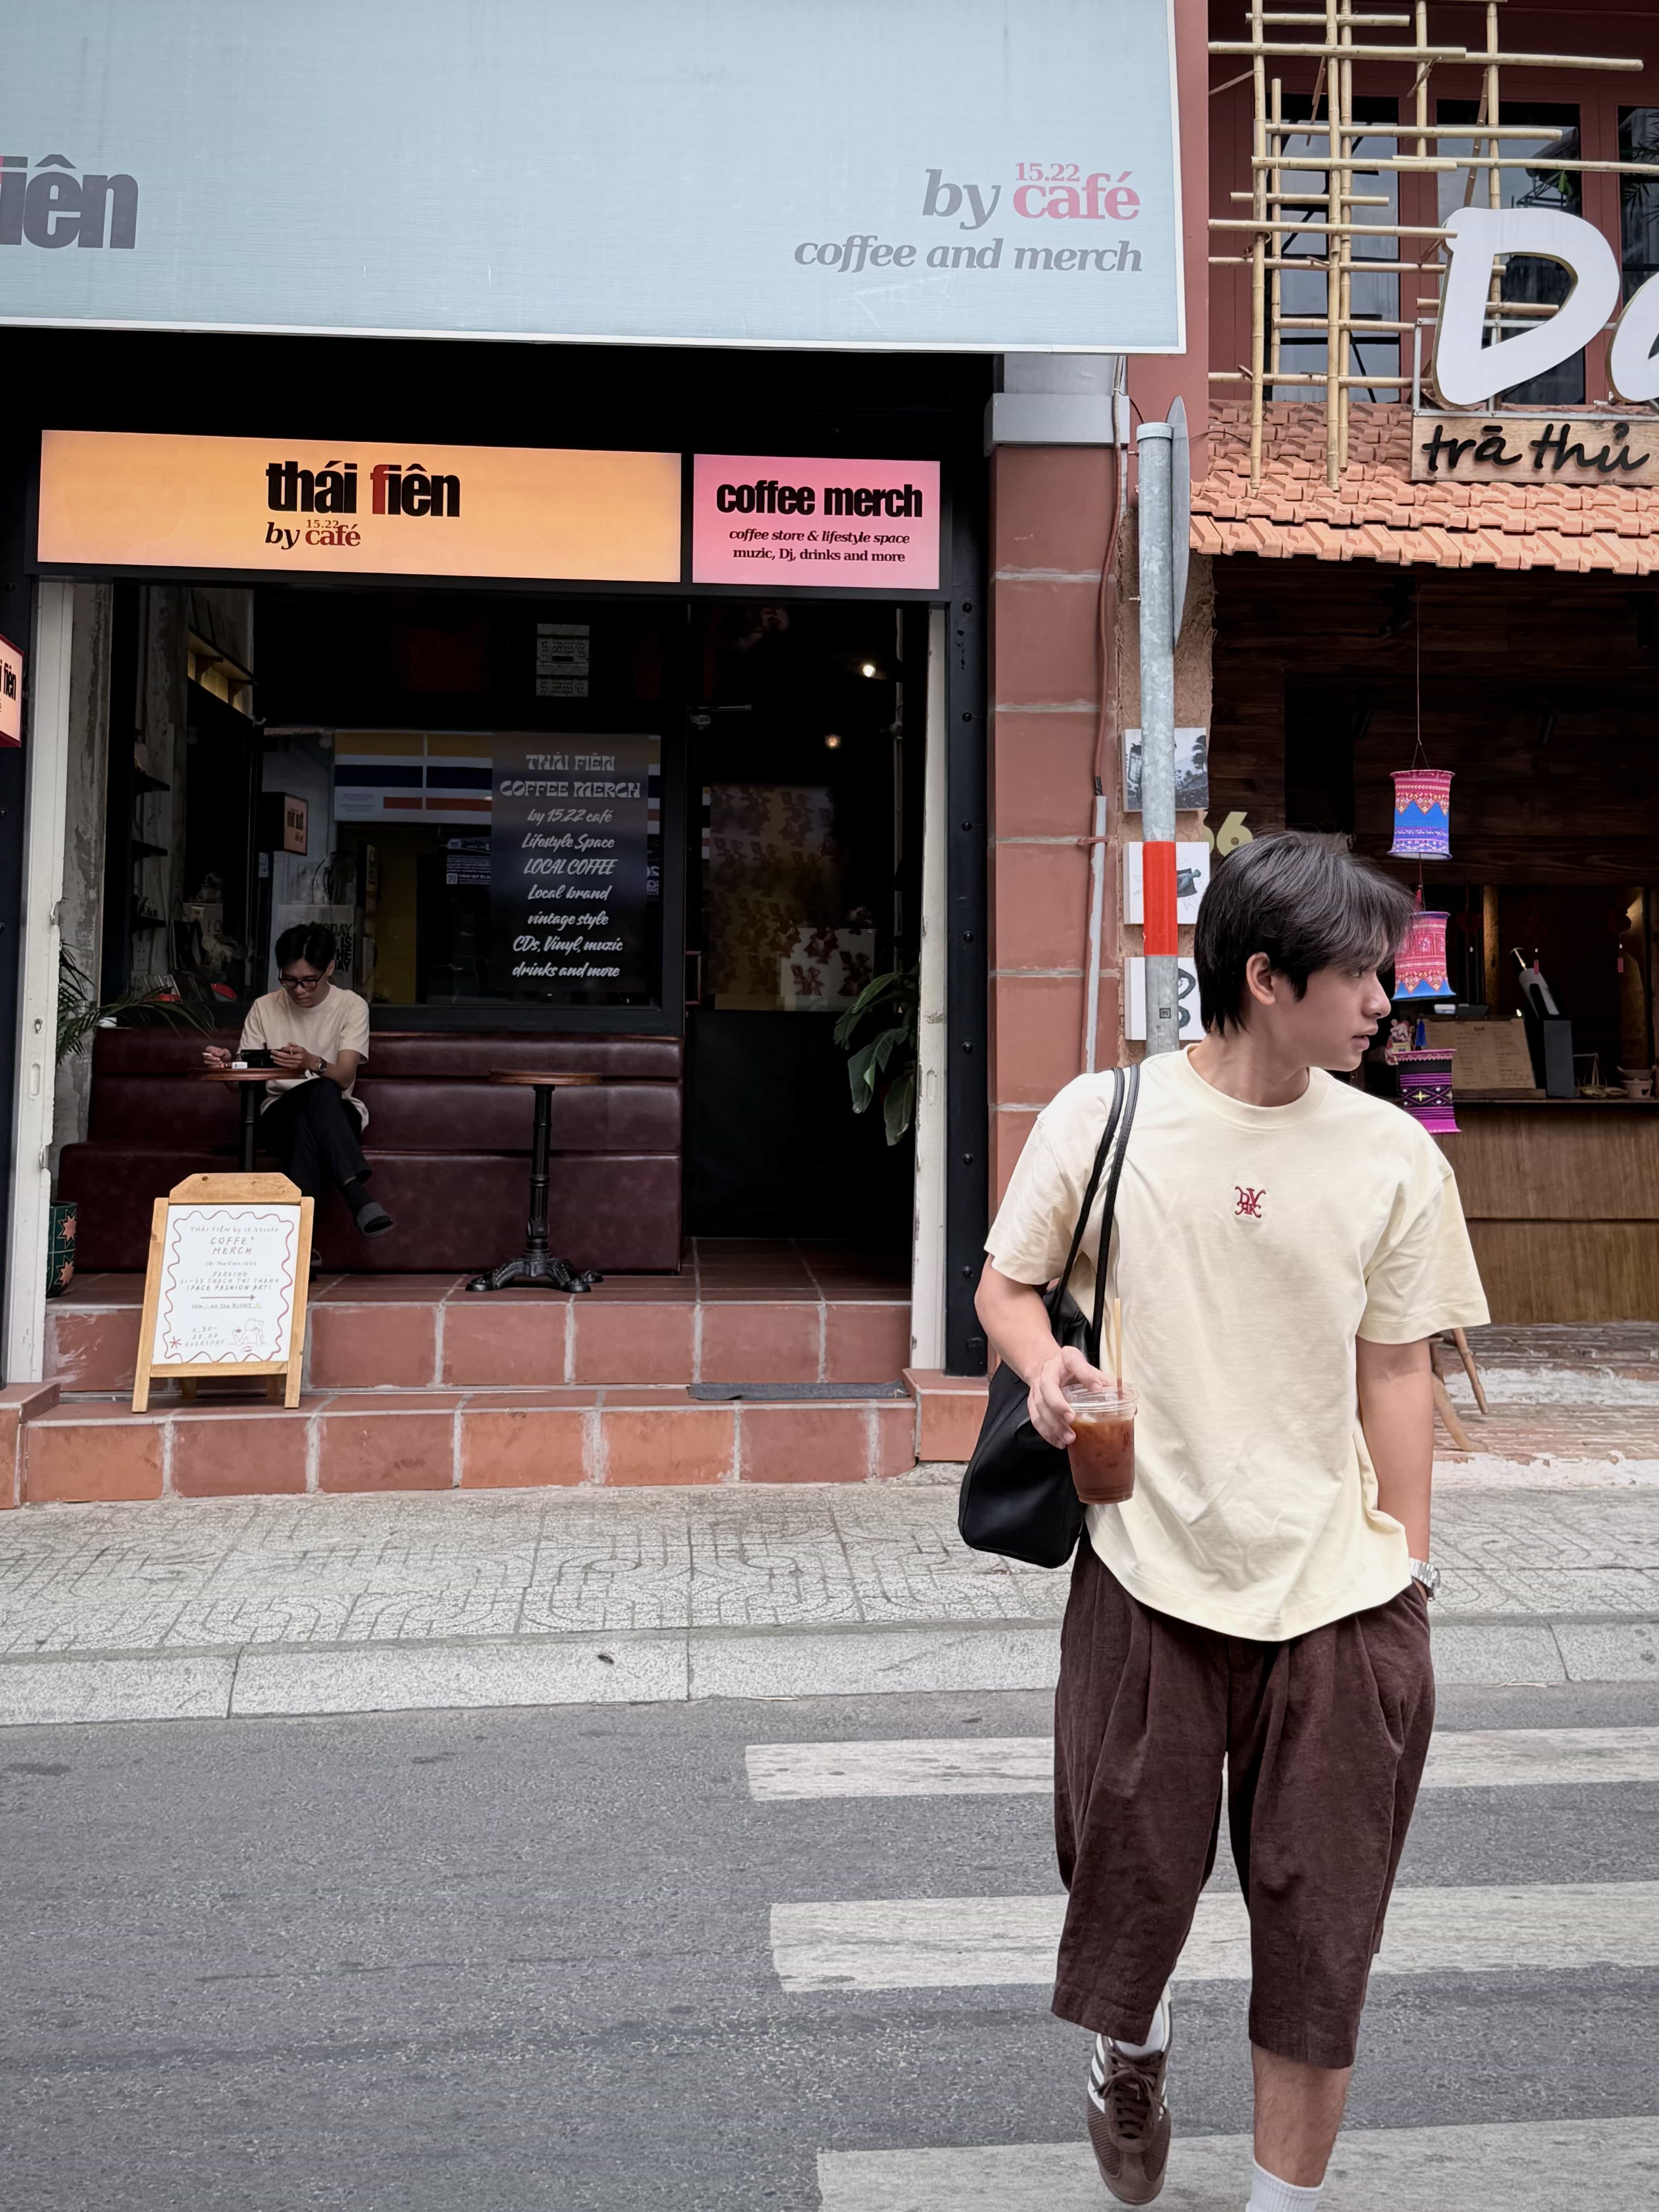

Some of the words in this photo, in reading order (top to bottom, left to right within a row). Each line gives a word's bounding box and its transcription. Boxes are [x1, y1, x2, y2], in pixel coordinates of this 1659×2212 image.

[1015, 162, 1080, 182] 15.22
[0, 154, 138, 249] iên
[922, 169, 1001, 230] by
[1012, 171, 1140, 220] café
[794, 235, 917, 273] coffee
[926, 238, 1004, 269] and
[1014, 240, 1143, 271] merch
[1529, 422, 1650, 473] thủ
[266, 461, 358, 514] thái
[370, 464, 460, 518] fiên
[717, 480, 815, 516] coffee
[824, 484, 923, 518] merch
[306, 520, 339, 529] 15.22
[265, 522, 300, 550] by
[305, 524, 361, 547] café
[729, 528, 769, 543] coffee
[771, 531, 804, 541] store
[807, 531, 819, 542] &
[822, 531, 870, 545] lifestyle
[873, 534, 910, 545] space
[732, 547, 775, 561] muzic,
[800, 549, 841, 561] drinks
[844, 550, 868, 562] and
[871, 553, 905, 562] more
[526, 752, 569, 771] THÁI
[574, 753, 615, 771] FIÊN
[500, 781, 569, 797] COFFEE
[573, 782, 640, 798] MERCH
[527, 809, 545, 826] by
[547, 809, 584, 823] 15.22
[586, 809, 613, 825] café
[522, 832, 574, 850] Lifestyle
[575, 834, 615, 852] Space
[523, 859, 565, 874] LOCAL
[567, 859, 618, 875] COFFEE
[528, 885, 565, 900] Local
[566, 886, 612, 901] brand
[528, 911, 576, 931] vintage
[577, 911, 609, 930] style
[513, 935, 541, 952] CDs,
[543, 936, 580, 955] Vinyl,
[583, 937, 623, 951] muzic
[512, 961, 557, 977] drinks
[559, 962, 586, 978] and
[586, 965, 620, 977] more
[212, 1247, 252, 1255] MERCH
[185, 1339, 225, 1347] EVERYDAY
